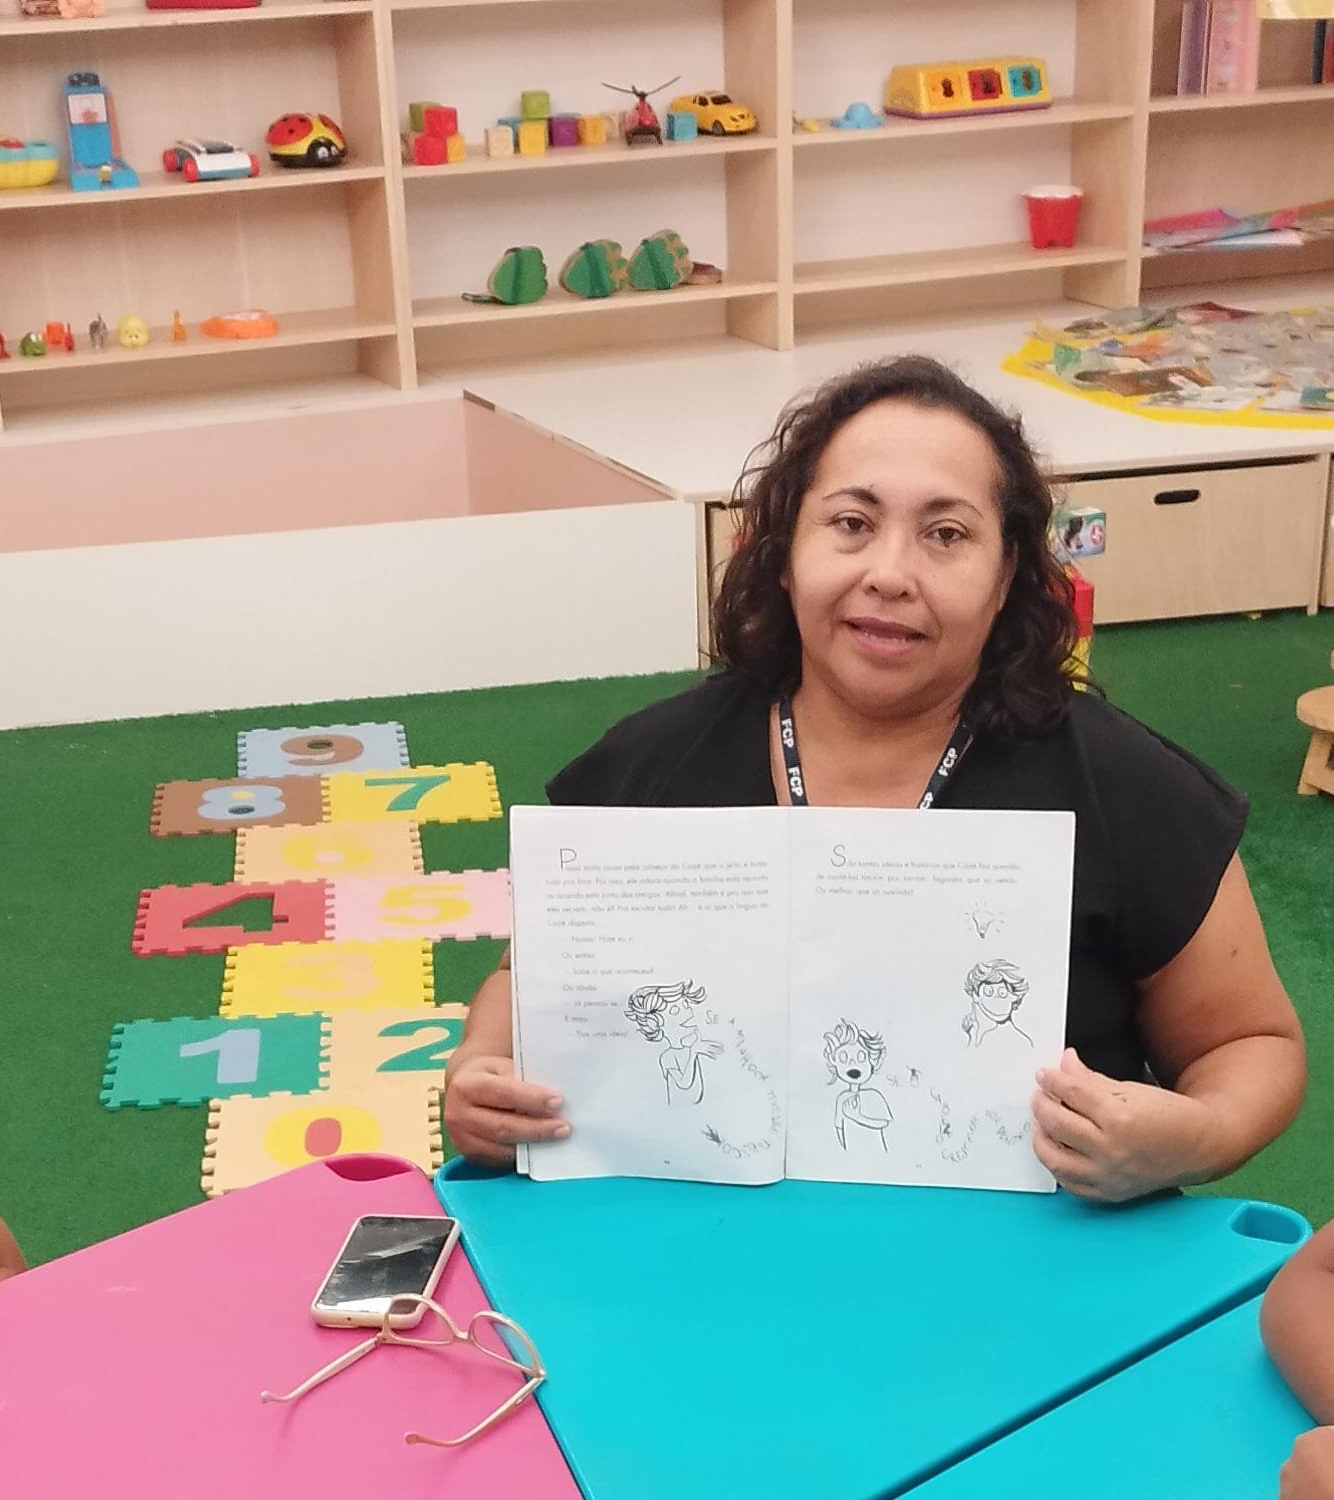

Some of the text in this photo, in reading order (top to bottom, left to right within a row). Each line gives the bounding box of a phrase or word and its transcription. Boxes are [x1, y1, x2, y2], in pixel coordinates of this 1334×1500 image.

[280, 734, 364, 766] 9
[781, 718, 795, 748] FCP
[937, 747, 958, 777] FCP
[365, 775, 451, 812] 7
[788, 766, 804, 797] FCP
[197, 785, 286, 820] 8
[916, 791, 934, 810] CP
[282, 834, 373, 870] 6
[182, 891, 289, 933] 4
[379, 883, 471, 926] 5
[278, 952, 380, 1000] 3
[179, 1029, 261, 1084] 1
[376, 1018, 467, 1073] 2
[263, 1105, 382, 1173] 0
